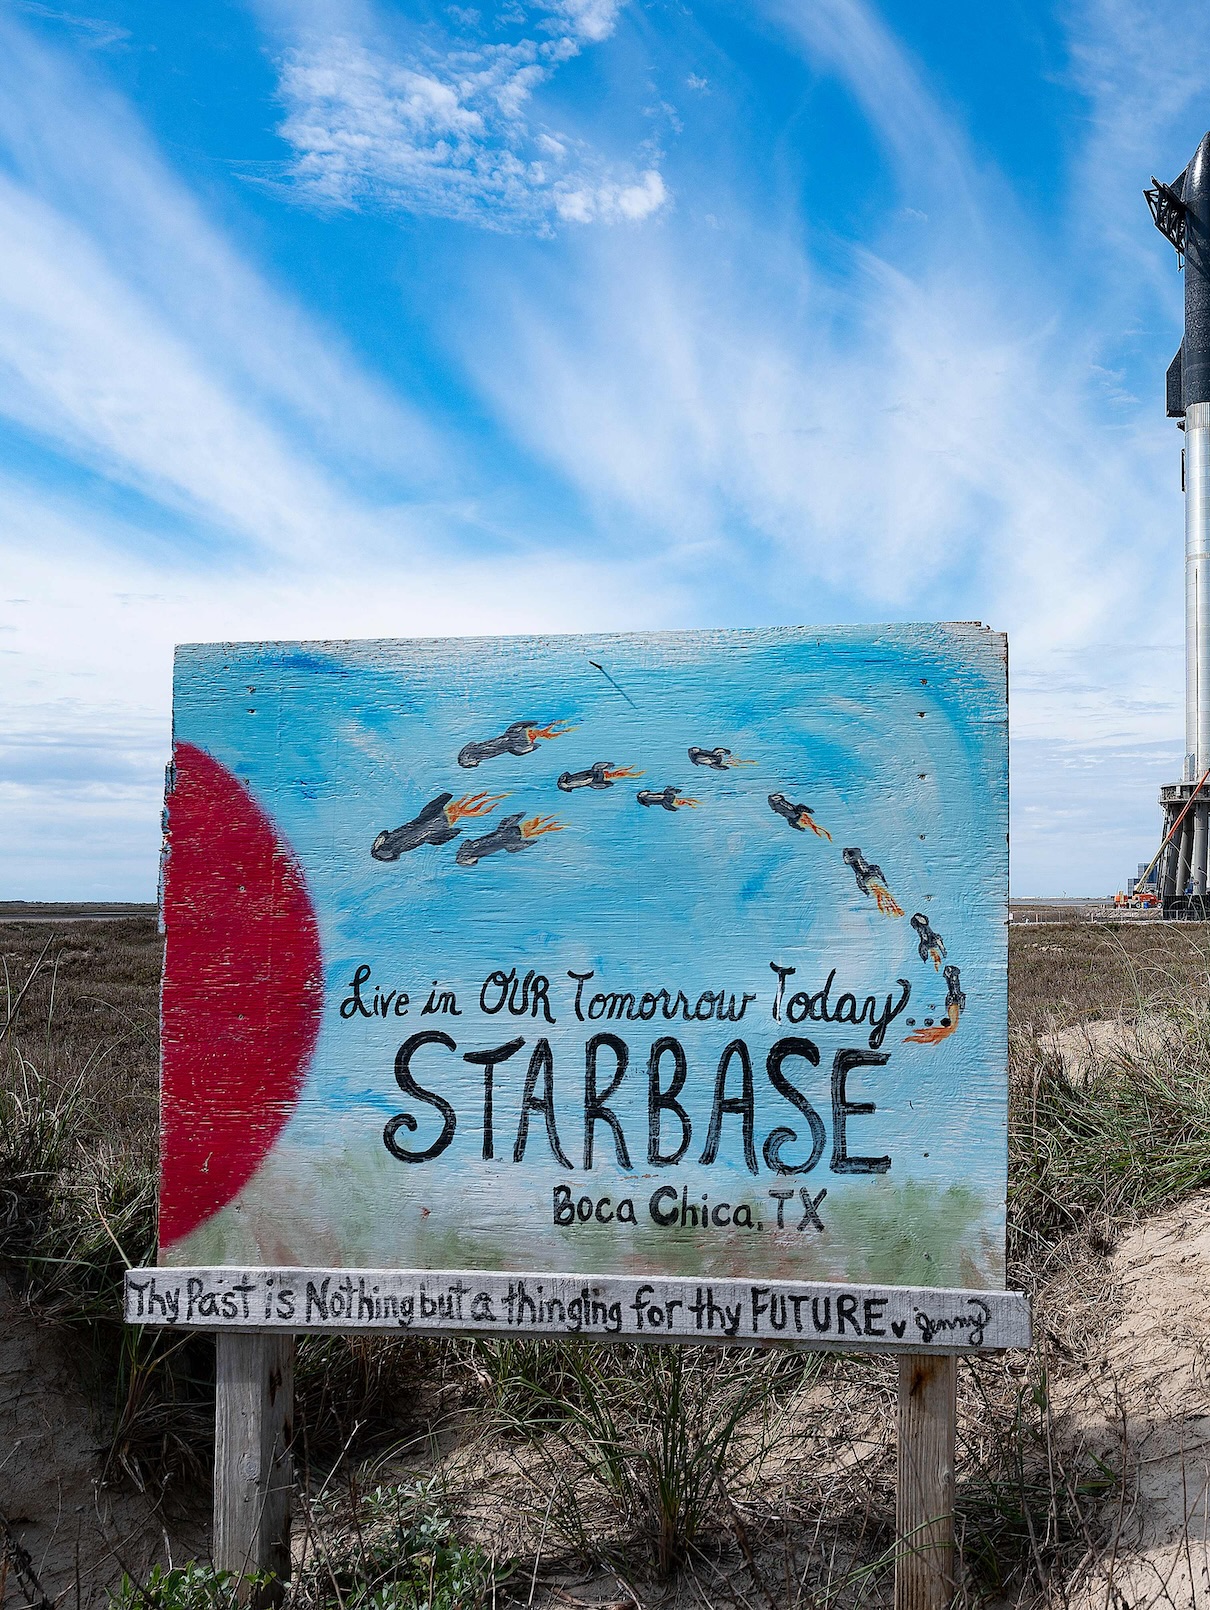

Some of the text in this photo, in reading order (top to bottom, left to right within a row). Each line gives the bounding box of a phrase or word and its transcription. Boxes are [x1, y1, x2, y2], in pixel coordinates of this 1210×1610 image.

[340, 964, 410, 1019] Live
[421, 980, 462, 1016] in
[567, 970, 756, 1022] Tomorrow
[383, 1030, 892, 1175] STARBASE
[553, 1185, 637, 1226] Boca
[768, 1186, 828, 1232] TX
[129, 1277, 180, 1323] Thy
[187, 1274, 256, 1321] Past
[265, 1278, 295, 1320] is
[306, 1276, 414, 1328] Nothing
[420, 1279, 472, 1320] but
[470, 1292, 497, 1322] a
[630, 1285, 682, 1330] for
[688, 1286, 740, 1336] thy
[752, 1286, 889, 1337] FUTURE
